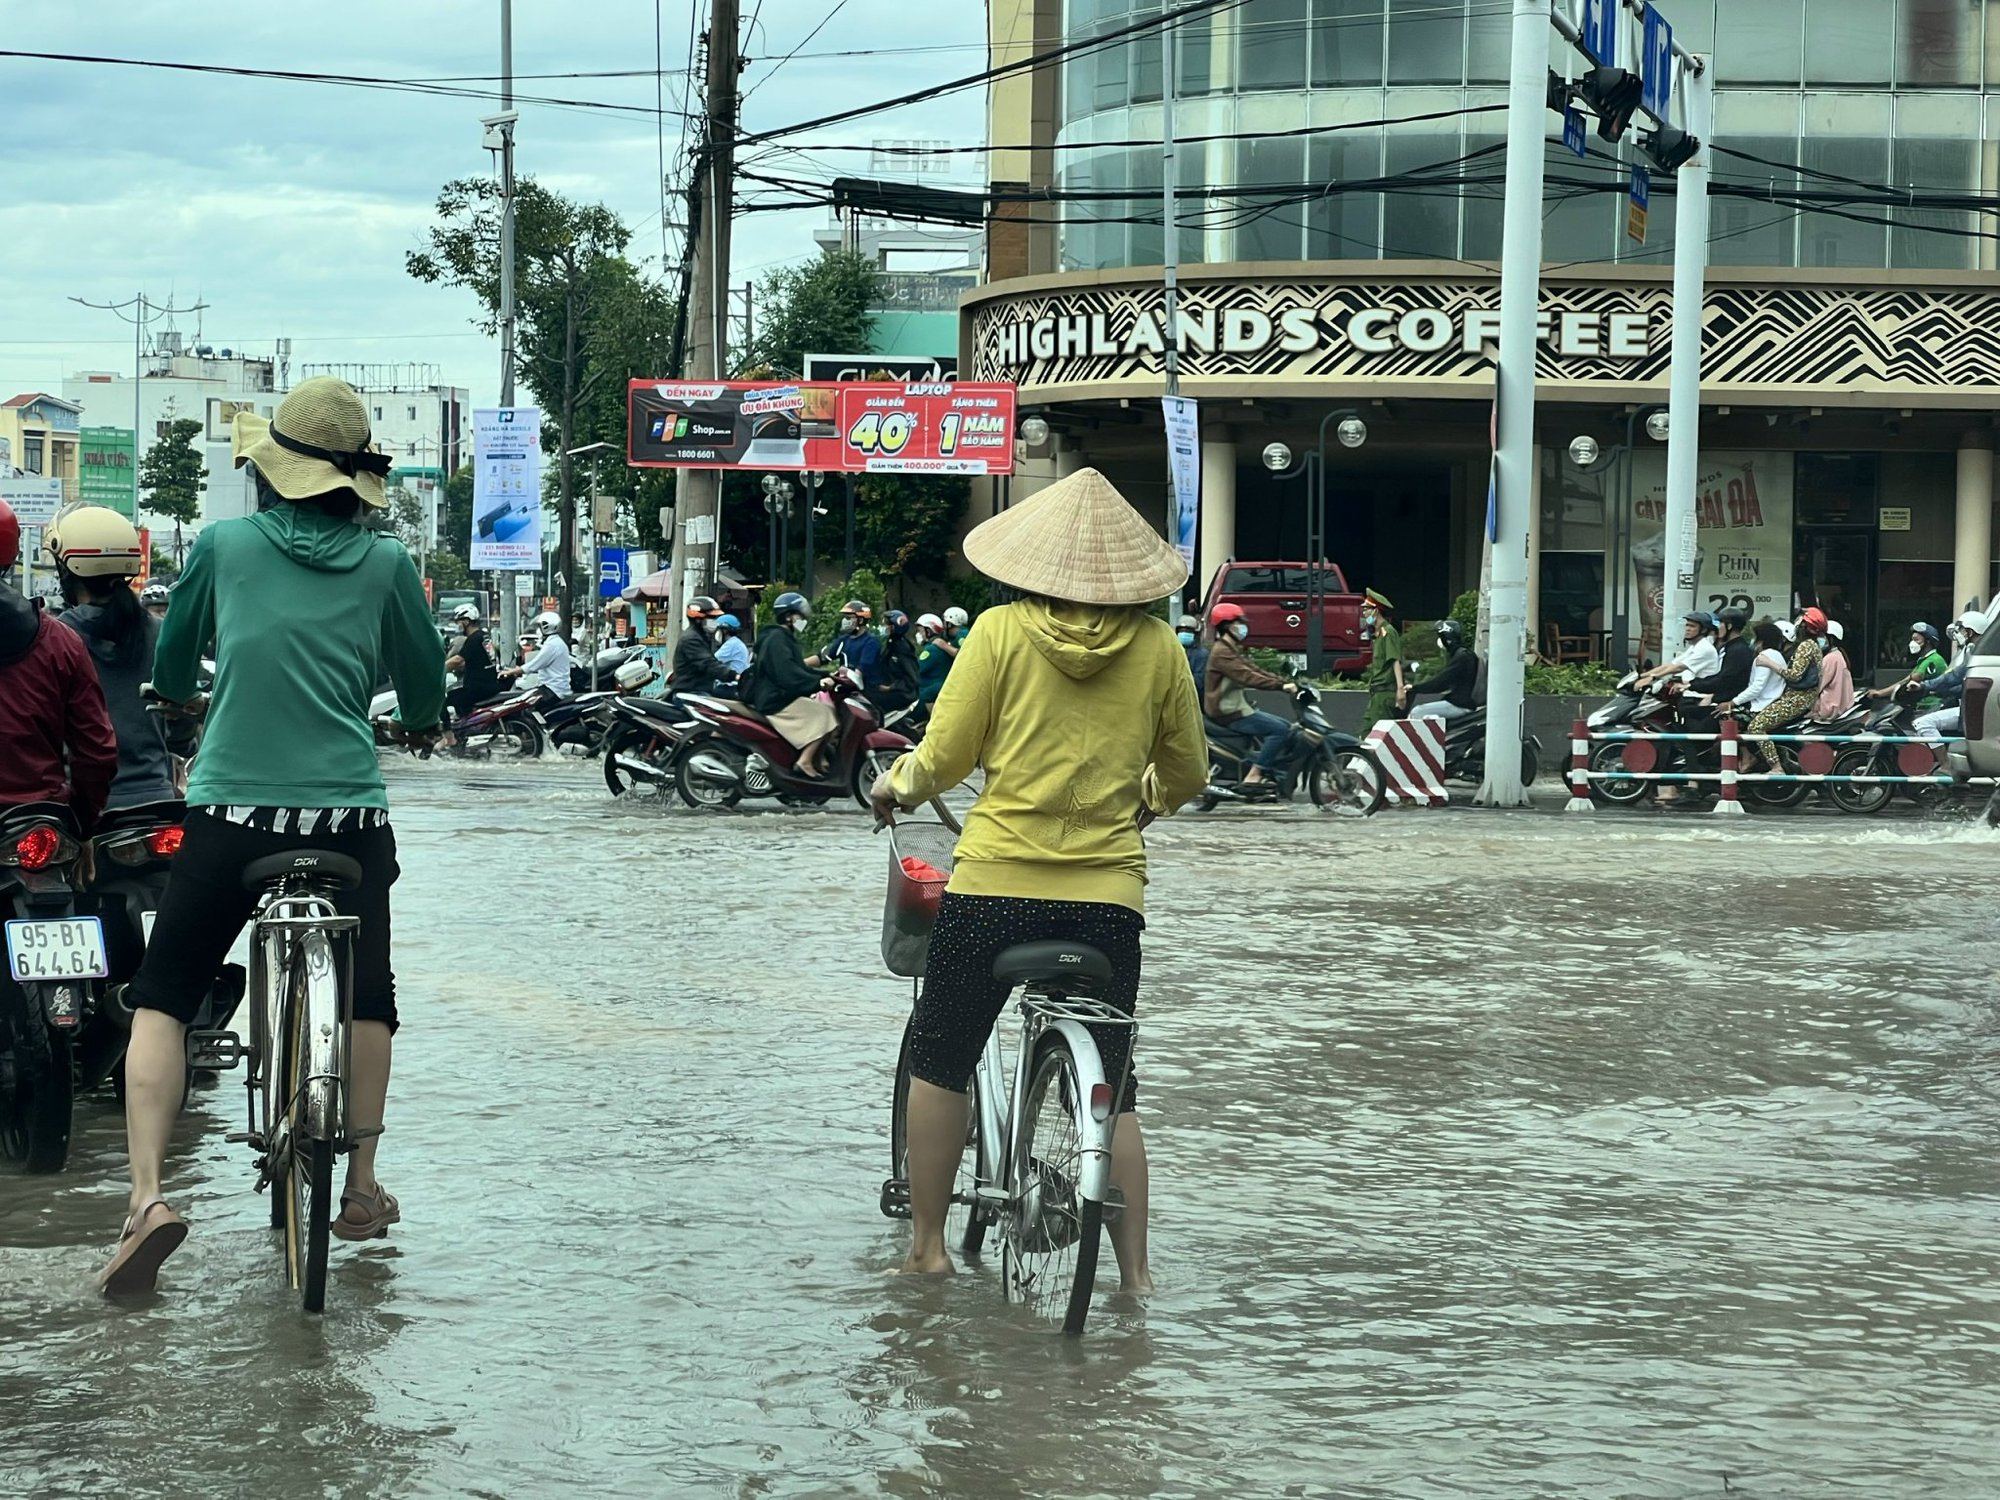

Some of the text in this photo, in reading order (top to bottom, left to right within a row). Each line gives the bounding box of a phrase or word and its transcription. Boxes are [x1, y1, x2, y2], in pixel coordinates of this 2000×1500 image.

[998, 307, 1319, 366] HIGHLANDS
[688, 388, 714, 398] NGAY
[905, 384, 952, 396] LAPTOP
[939, 413, 1006, 457] 1 NĂM
[677, 450, 696, 459] 1800
[697, 450, 715, 459] 6601
[1653, 470, 1722, 492] HINDS
[22, 922, 87, 949] 95-B1
[17, 950, 102, 977] 644.64
